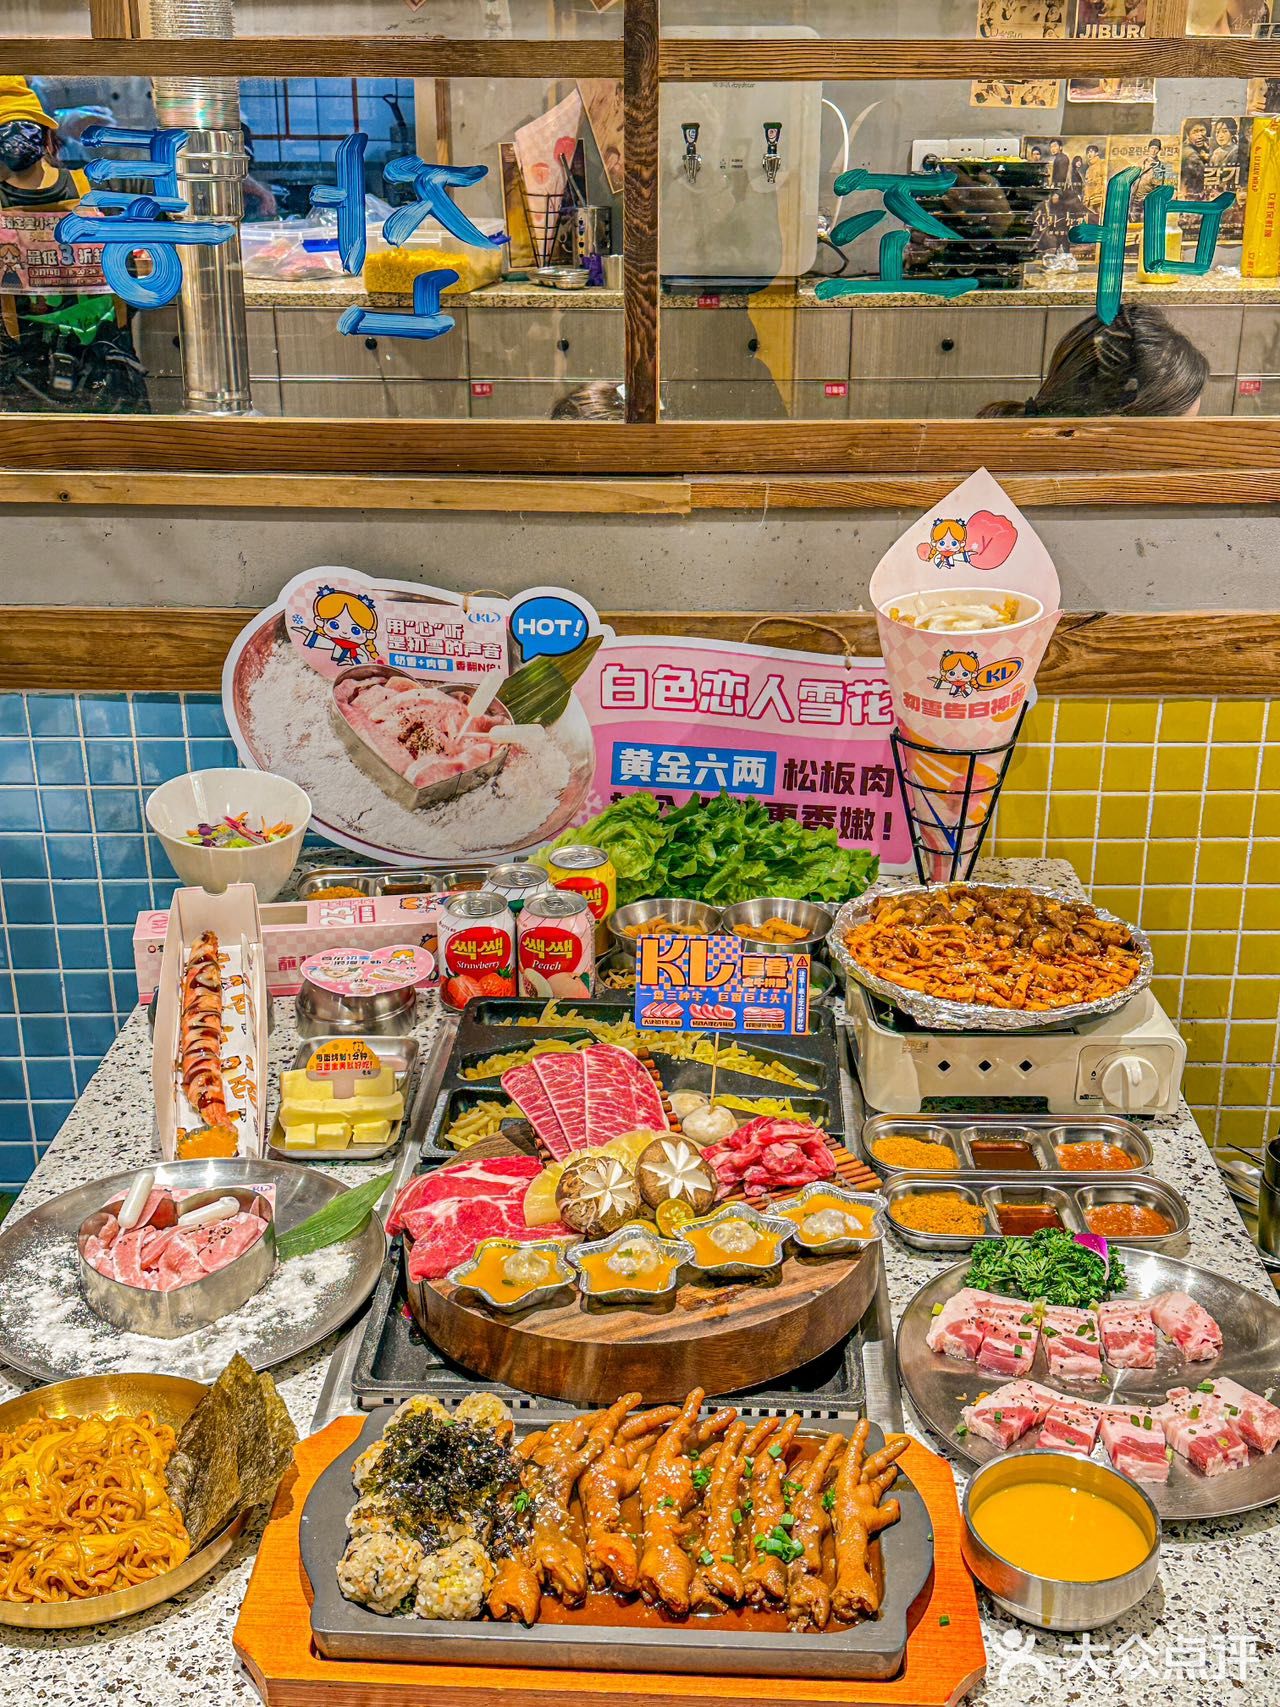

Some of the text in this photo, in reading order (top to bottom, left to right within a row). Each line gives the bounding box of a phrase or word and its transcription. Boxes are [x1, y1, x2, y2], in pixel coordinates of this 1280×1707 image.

[518, 617, 584, 638] HOT!
[600, 662, 894, 726] 白色恋人雪花
[617, 747, 894, 798] 黄金六两 松板肉
[456, 959, 501, 970] Strawberry
[532, 959, 563, 971] Peach
[640, 937, 737, 987] KL
